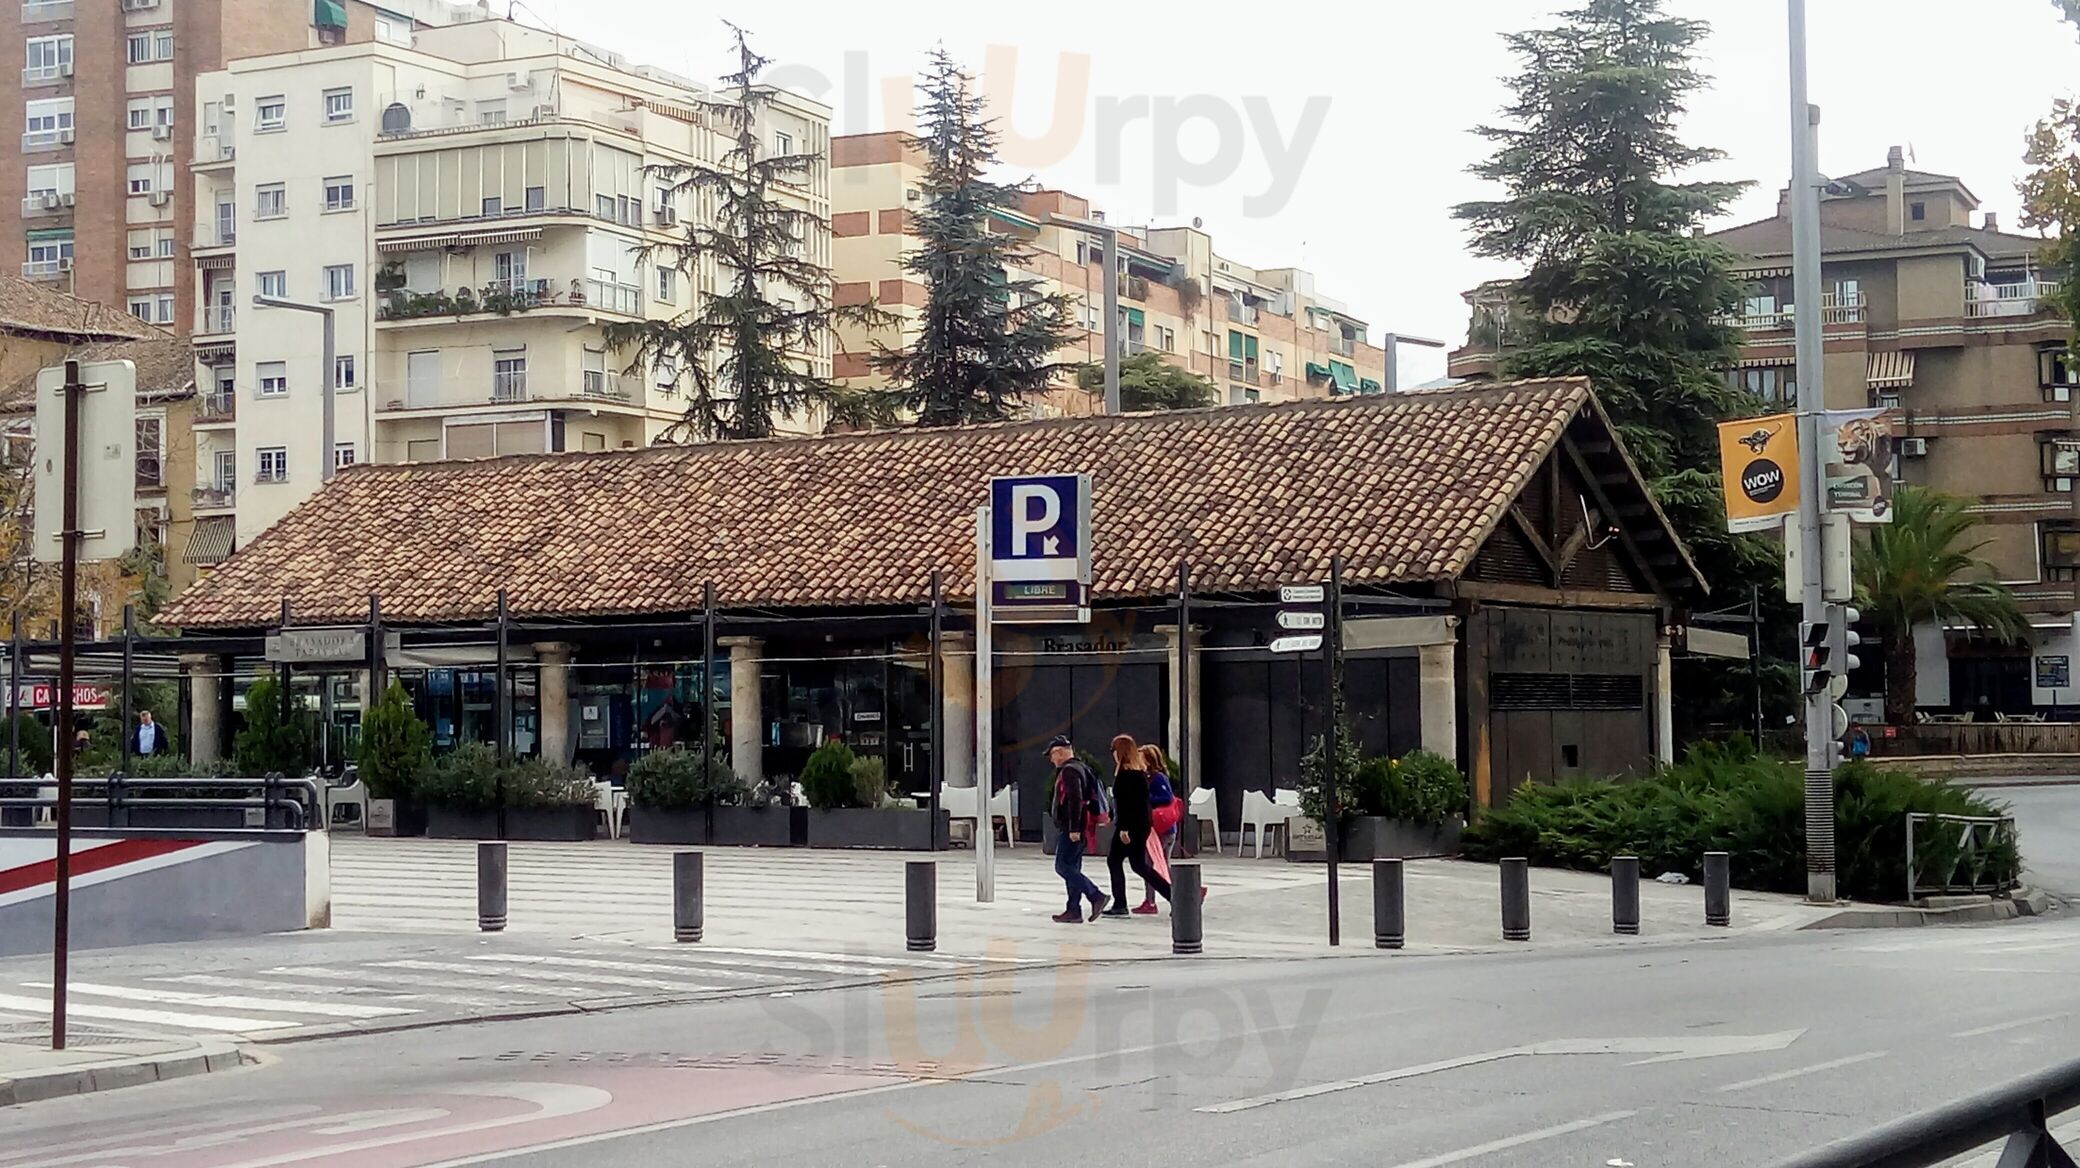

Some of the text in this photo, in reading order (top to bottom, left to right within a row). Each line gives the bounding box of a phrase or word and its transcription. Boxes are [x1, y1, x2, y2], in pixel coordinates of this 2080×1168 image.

[1744, 470, 1779, 490] WOW
[1012, 484, 1061, 556] P
[1024, 584, 1056, 595] LIBRE
[1043, 635, 1129, 653] Brasador
